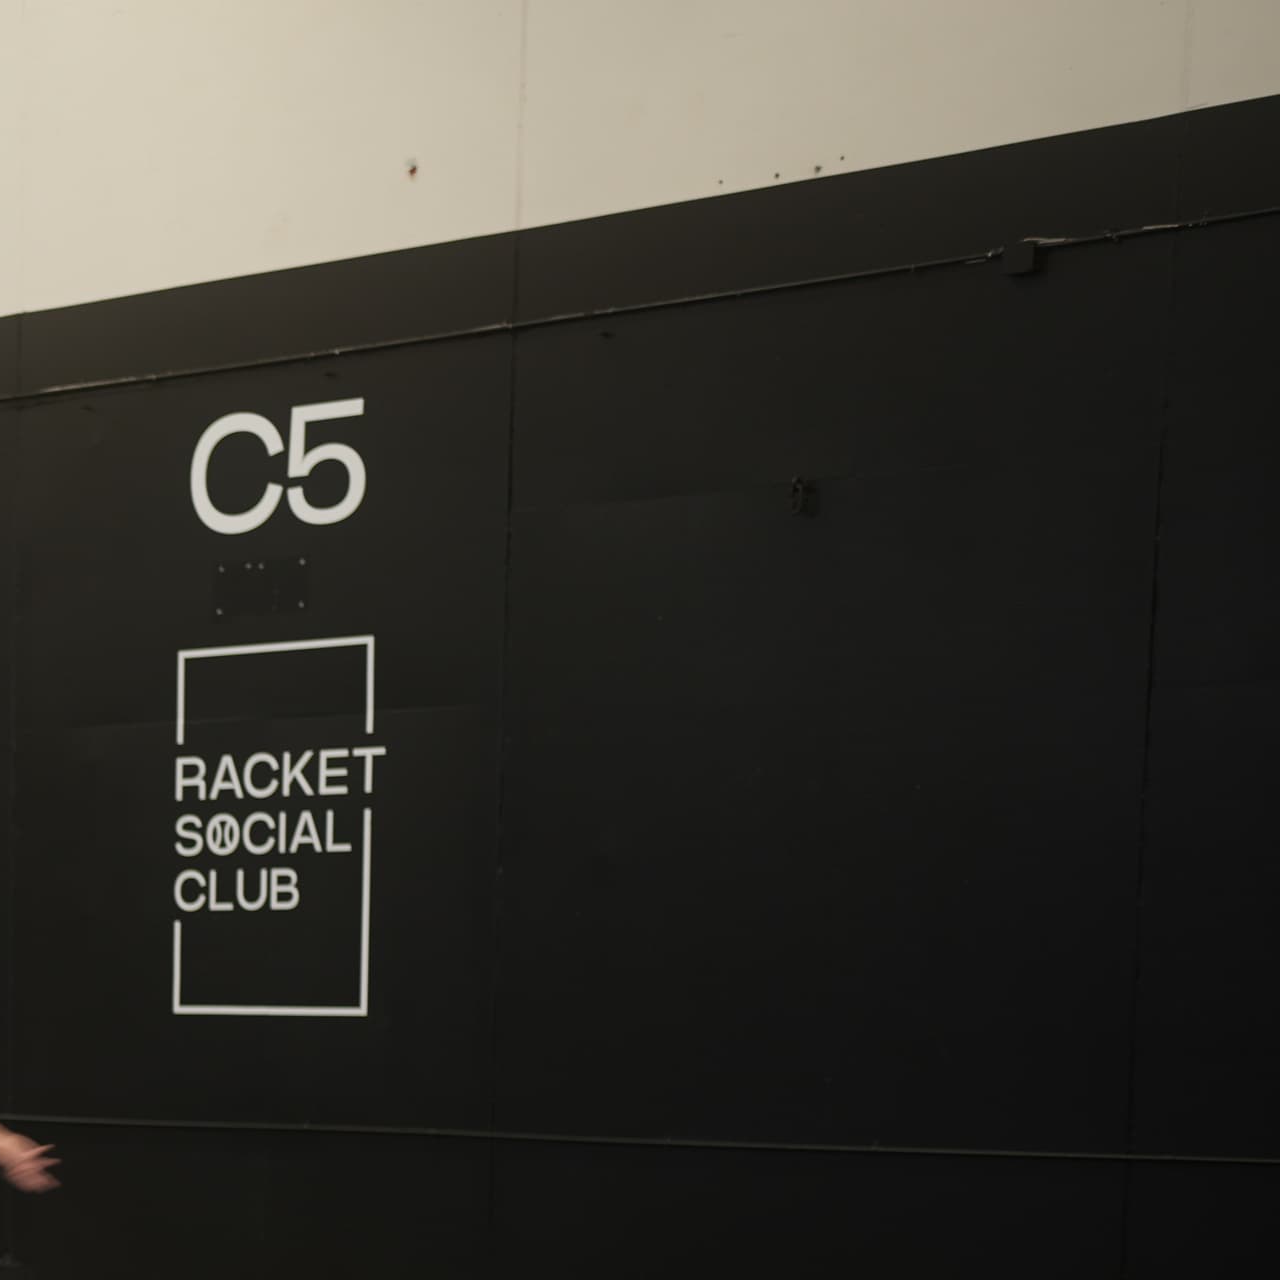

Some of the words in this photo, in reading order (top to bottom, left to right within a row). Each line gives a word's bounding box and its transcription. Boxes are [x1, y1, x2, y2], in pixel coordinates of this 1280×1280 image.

[189, 397, 367, 535] C5
[175, 746, 386, 801] RACKET
[175, 808, 352, 857] SOCIAL
[173, 867, 300, 912] CLUB
